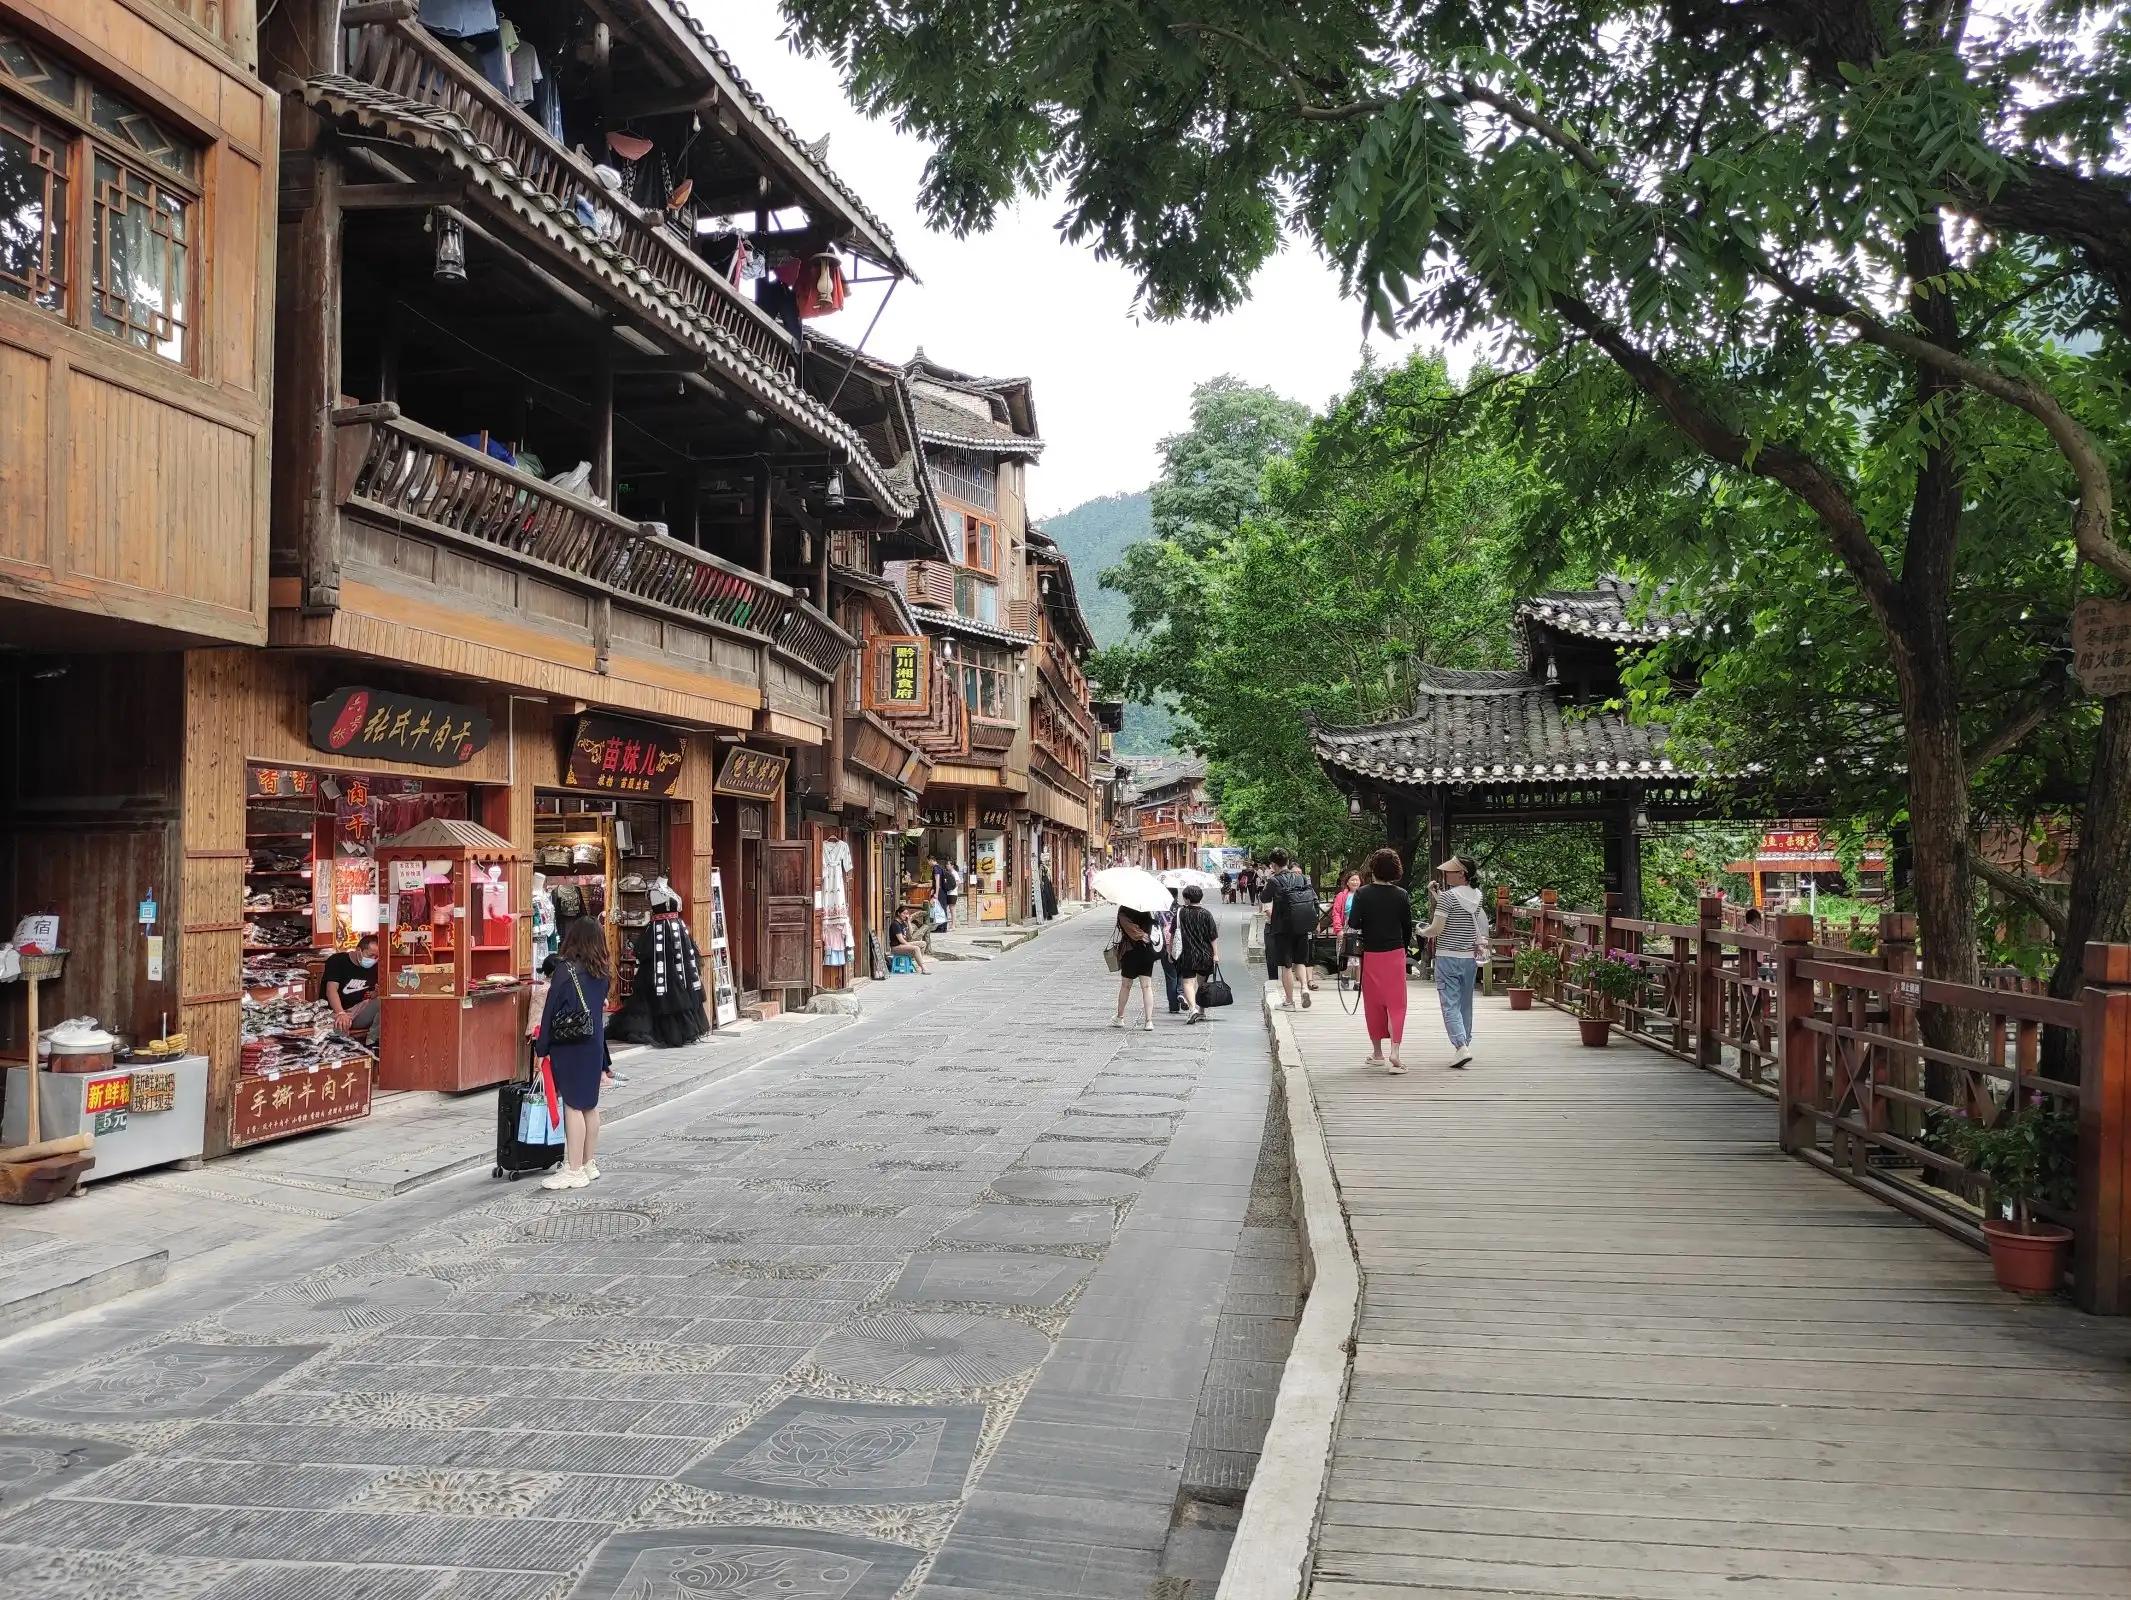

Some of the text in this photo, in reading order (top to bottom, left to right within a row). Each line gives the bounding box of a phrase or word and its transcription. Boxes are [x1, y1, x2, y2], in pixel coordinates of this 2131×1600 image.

[895, 647, 915, 698] 黔川湘食府
[363, 704, 472, 754] 张氏牛肉干
[602, 735, 656, 776] 苗妹儿
[250, 1071, 358, 1118] 手撕牛肉干
[103, 1109, 127, 1128] 5元
